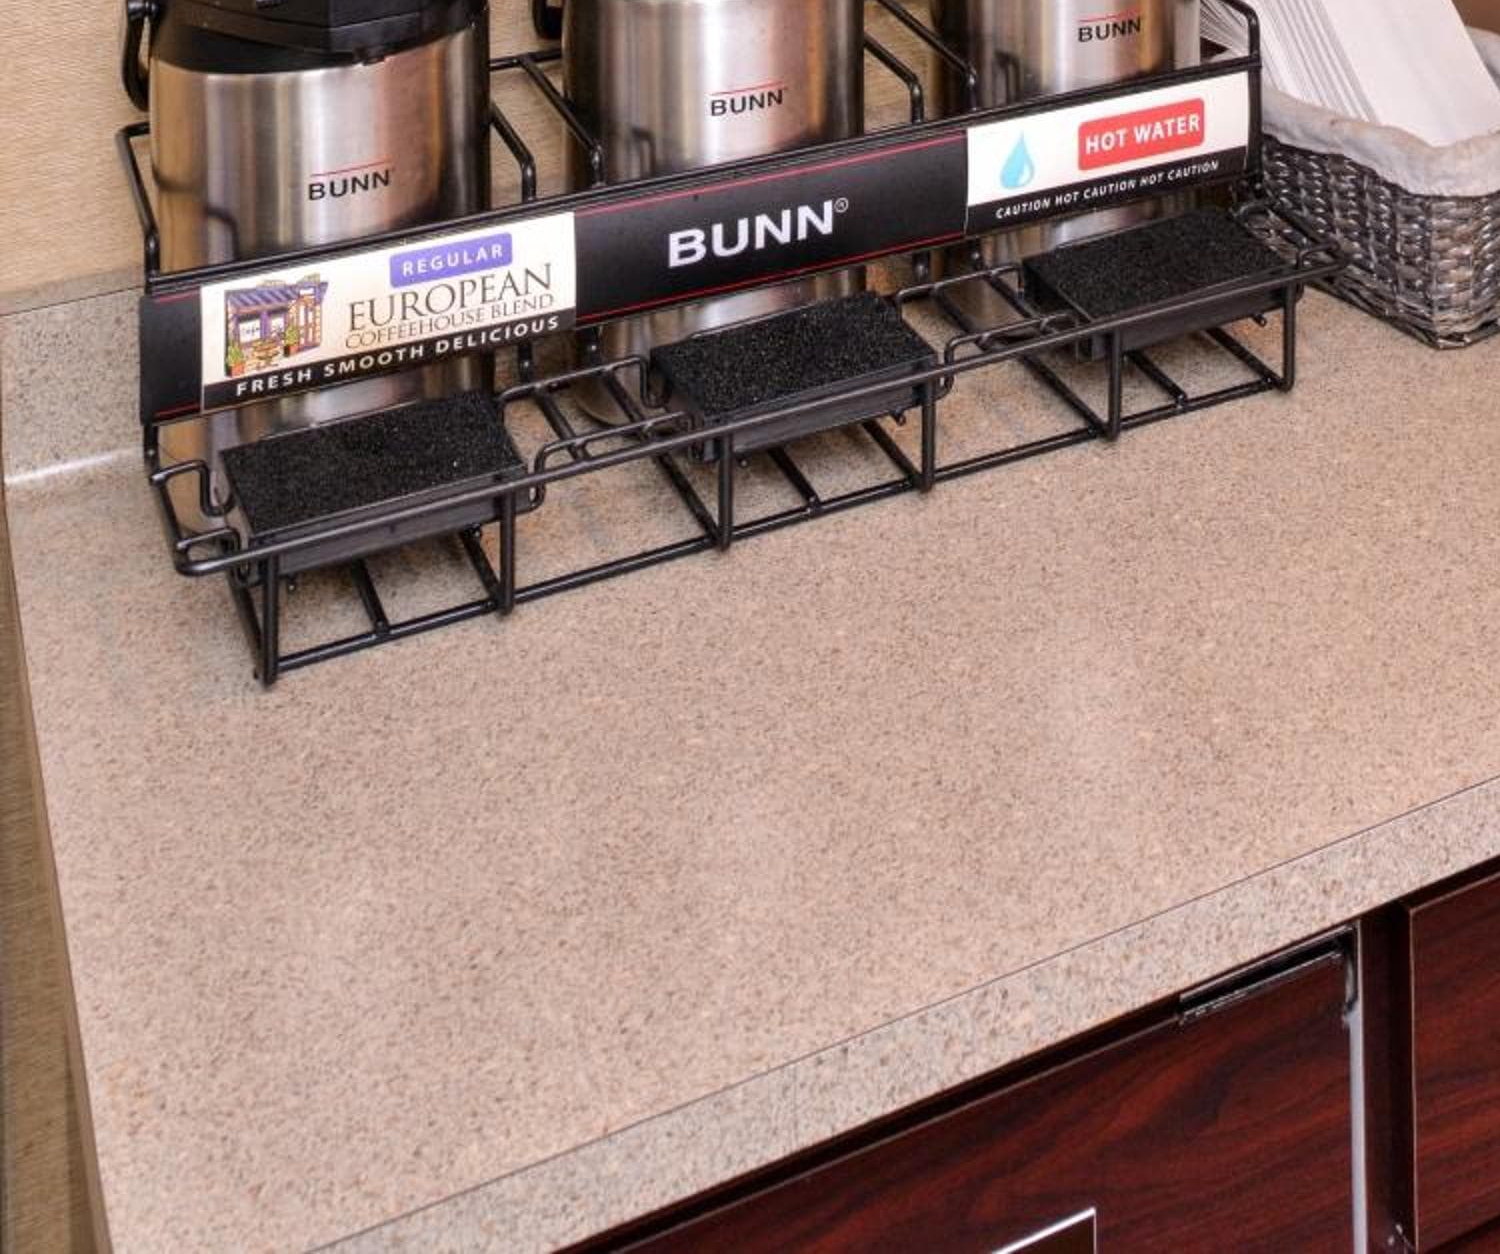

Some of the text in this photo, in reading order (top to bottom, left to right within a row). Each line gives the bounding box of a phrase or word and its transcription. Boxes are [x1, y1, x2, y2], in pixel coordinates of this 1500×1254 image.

[1078, 16, 1141, 43] BUNN
[710, 88, 785, 118] BUNN
[1085, 113, 1201, 155] HOT WATER
[308, 169, 391, 202] BUNN
[995, 159, 1219, 220] CAUTION HOT CAUTION HOT CAUTION
[402, 244, 503, 277] REGULAR
[347, 262, 552, 333] EUROPEAN
[345, 293, 555, 350] COFFEEHOUSE BLEND
[235, 316, 561, 397] FRESH SMOOTH DELICIOUS
